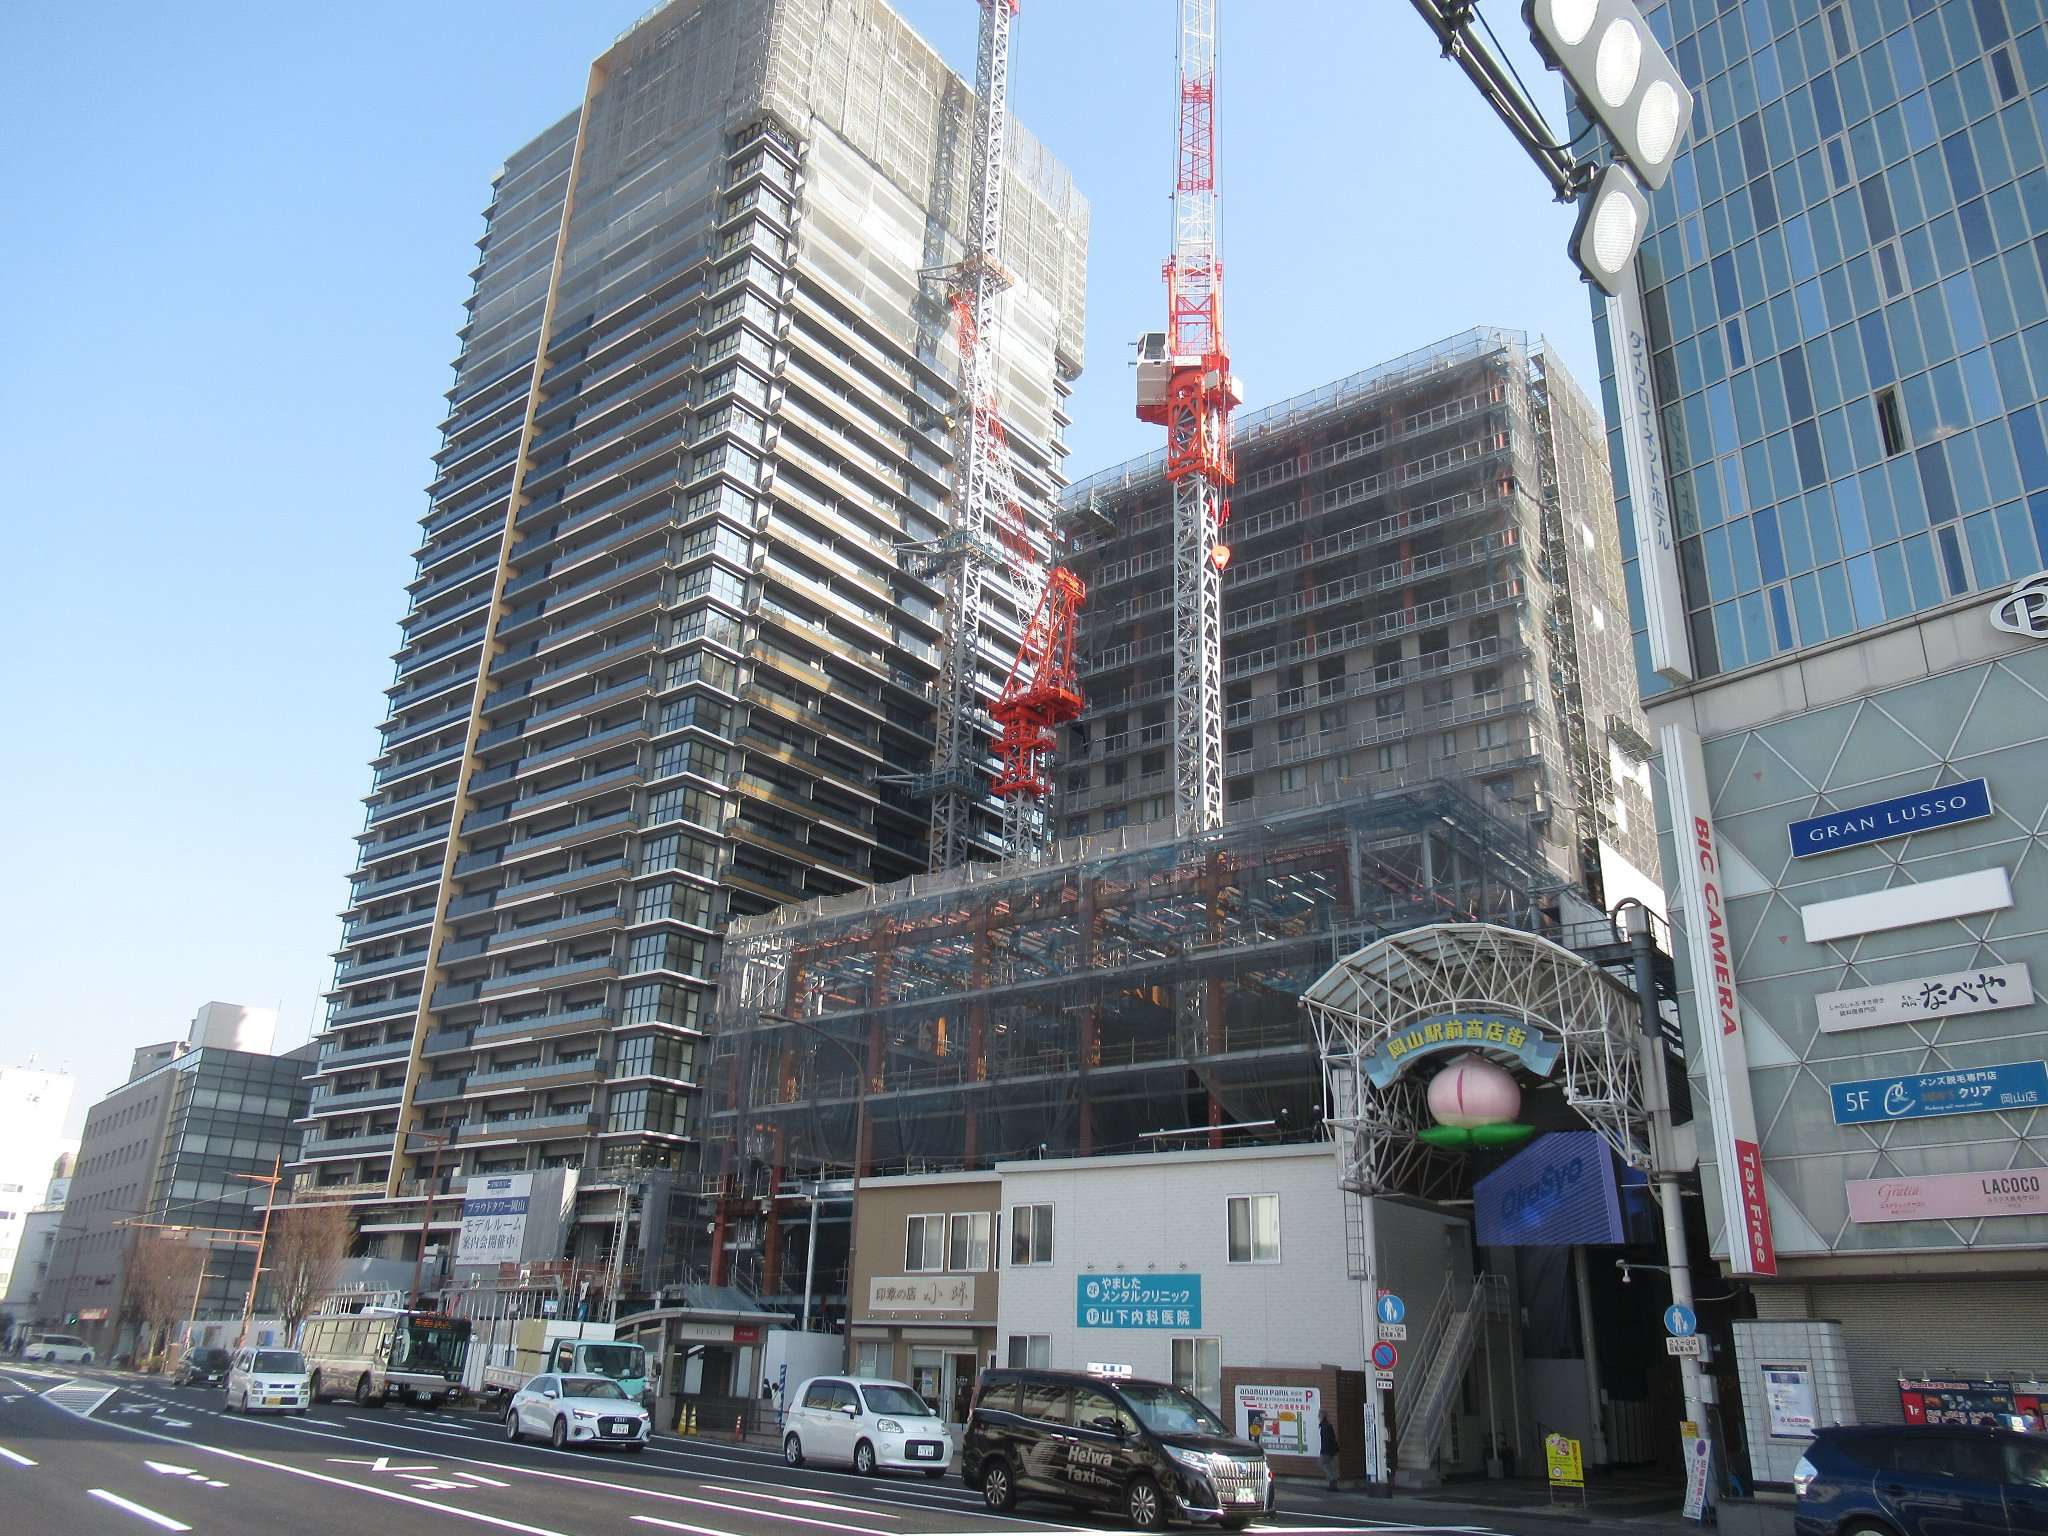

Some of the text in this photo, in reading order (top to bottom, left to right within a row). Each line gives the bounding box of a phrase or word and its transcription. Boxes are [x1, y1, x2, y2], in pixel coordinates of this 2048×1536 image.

[1630, 331, 1670, 550] ダイワロイネットホテル
[1809, 796, 1967, 841] GRAN LUSSO
[1695, 816, 1737, 1036] BIC CAMERA
[1920, 973, 2006, 1010] なべや
[1386, 1018, 1528, 1060] 岡山駅前商店街
[1919, 1071, 1997, 1087] メンズ脱毛専門店
[1846, 1091, 1870, 1112] 5F
[1958, 1085, 1992, 1099] クリア
[2000, 1091, 2038, 1105] 岡山店
[1982, 1176, 2040, 1195] LACOCO
[467, 1199, 526, 1212] プラウドタワー岡山
[1743, 1152, 1766, 1263] Tax Free
[464, 1217, 521, 1233] モデルルーム
[1101, 1277, 1141, 1290] やました
[1101, 1290, 1190, 1303] メンタルクリニック
[1101, 1308, 1190, 1326] 山下内科医院
[1305, 1390, 1313, 1403] P
[1068, 1445, 1113, 1467] Heiwa
[1065, 1463, 1096, 1483] Taxi
